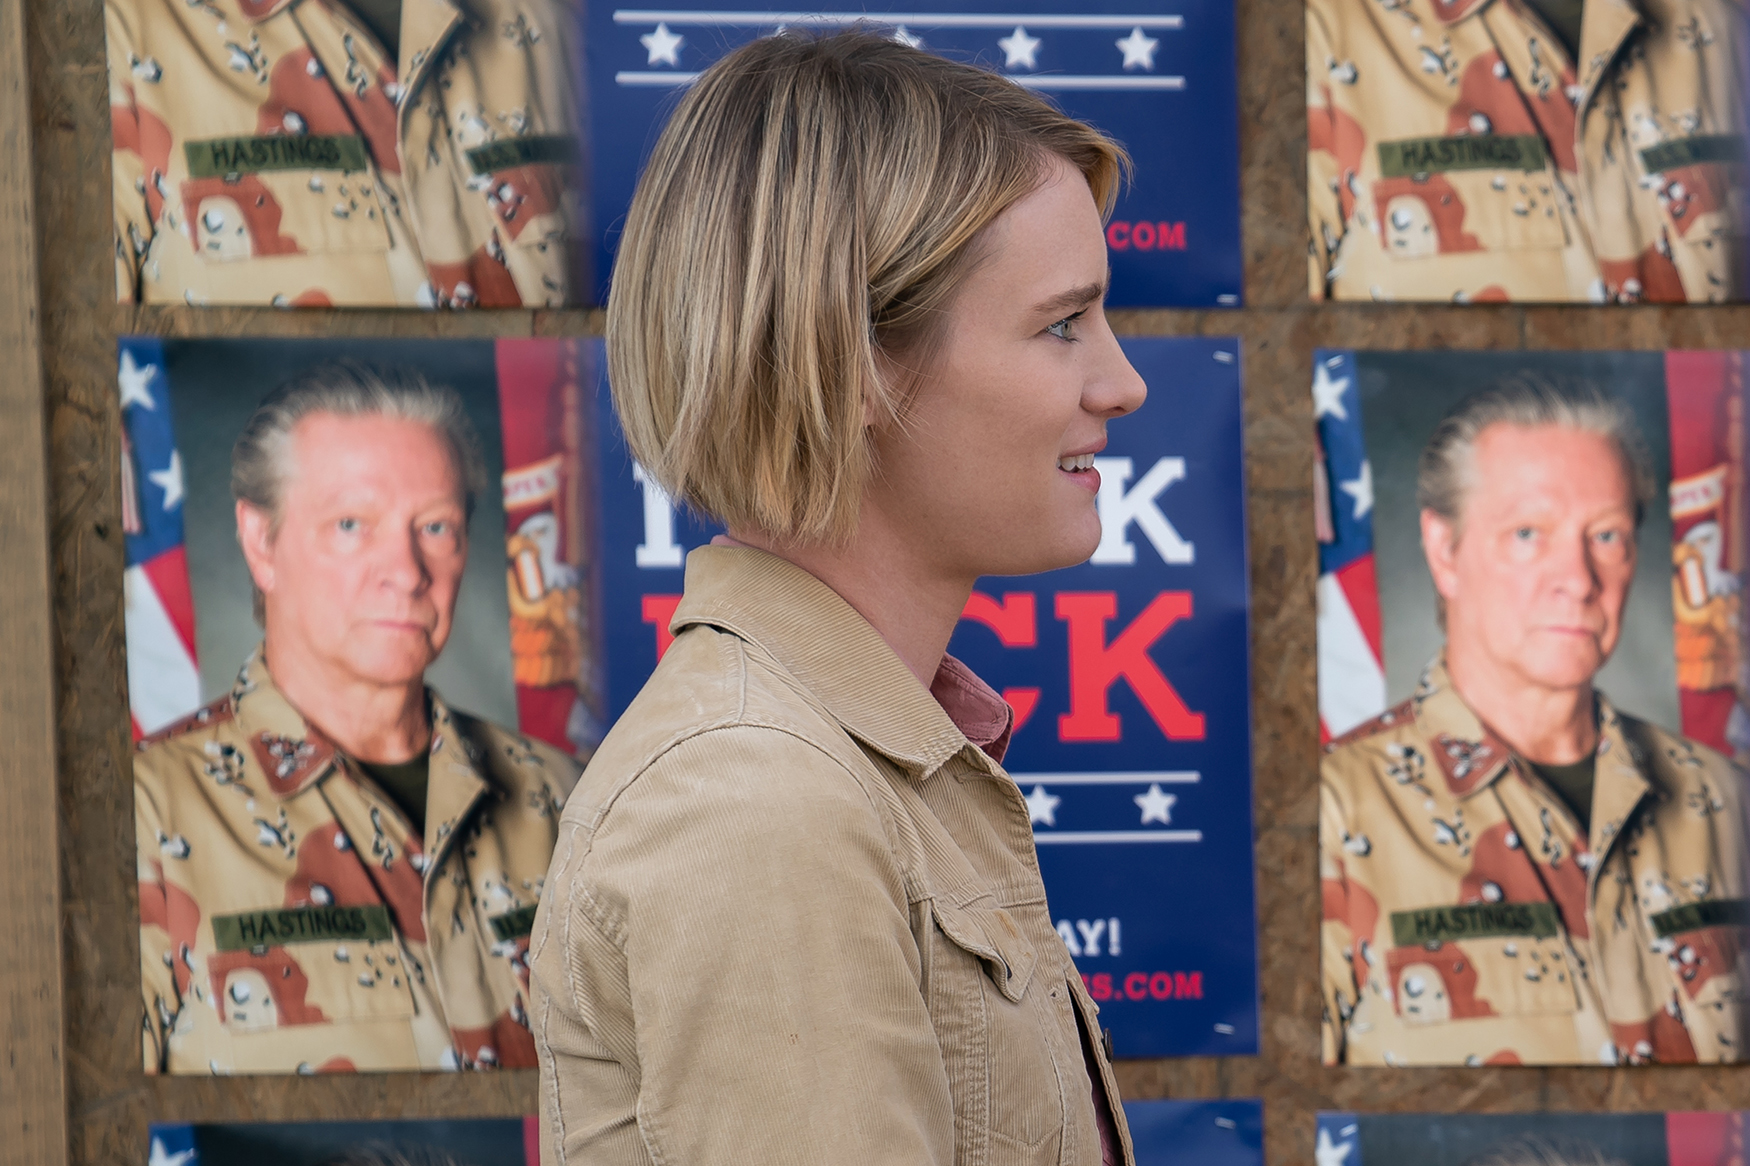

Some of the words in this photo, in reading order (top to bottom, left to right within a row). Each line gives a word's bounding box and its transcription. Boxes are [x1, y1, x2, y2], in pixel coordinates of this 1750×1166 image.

[210, 137, 341, 169] HASTINGS
[238, 906, 367, 941] HASTINGS
[1056, 917, 1122, 957] AY!
